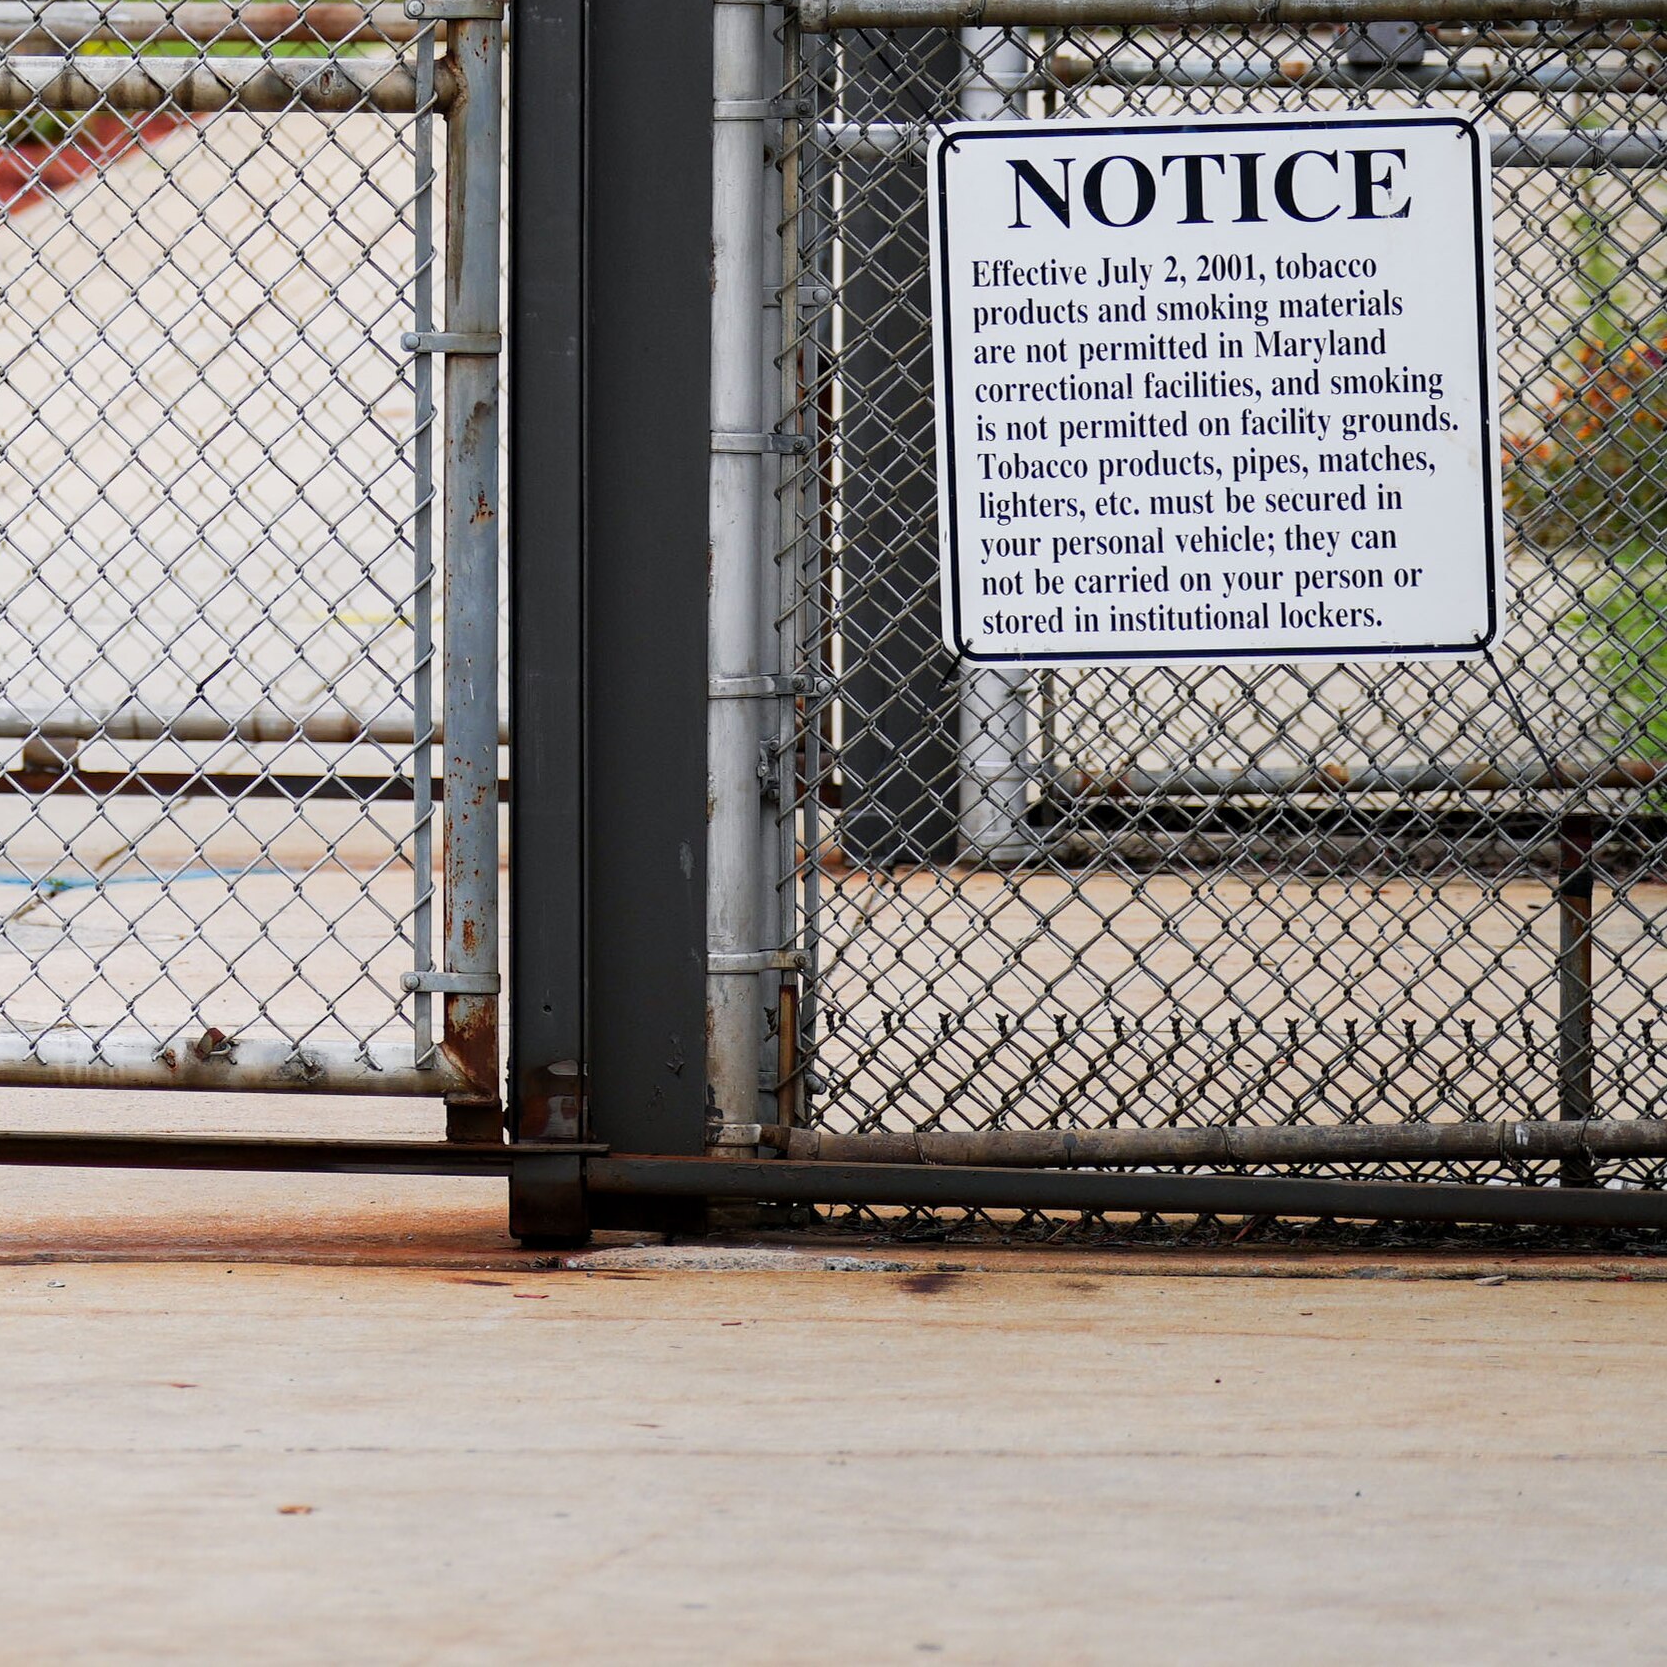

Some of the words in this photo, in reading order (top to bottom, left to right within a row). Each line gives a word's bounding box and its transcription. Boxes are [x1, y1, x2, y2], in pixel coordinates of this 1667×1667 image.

[1006, 149, 1411, 229] NOTICE
[972, 259, 1087, 287] Effective
[1097, 257, 1152, 290] July
[1164, 256, 1186, 287] 2,
[1197, 254, 1265, 285] 2001,
[1275, 252, 1376, 280] tobacco
[973, 298, 1088, 333] products
[1098, 295, 1146, 323] and
[1157, 293, 1269, 326] smoking
[1280, 289, 1403, 318] materials
[974, 345, 1015, 364] are
[1027, 339, 1067, 363] not
[1079, 333, 1207, 369] permitted
[1219, 332, 1243, 358] in
[1254, 328, 1386, 364] Maryland
[975, 373, 1133, 403] correctional
[1144, 370, 1261, 401] facilities,
[1272, 369, 1319, 396] and
[1331, 366, 1443, 400] smoking
[977, 415, 996, 441] is
[1007, 416, 1048, 440] not
[1060, 410, 1187, 447] permitted
[1199, 418, 1230, 436] on
[1241, 407, 1331, 441] facility
[1342, 405, 1458, 441] grounds.
[977, 453, 1088, 479] Tobacco
[1099, 450, 1222, 485] products,
[1233, 447, 1308, 482] pipes,
[1319, 445, 1435, 475] matches,
[979, 492, 1085, 526] lighters,
[1096, 492, 1139, 516] etc.
[1150, 490, 1214, 514] must
[1225, 487, 1255, 513] be
[1266, 484, 1366, 512] secured
[1377, 483, 1402, 510] in
[981, 537, 1041, 564] your
[1052, 527, 1164, 563] personal
[1175, 525, 1274, 556] vehicle;
[1285, 524, 1340, 557] they
[1351, 530, 1397, 549] can
[982, 571, 1023, 596] not
[1035, 568, 1064, 595] be
[1075, 566, 1169, 594] carried
[1180, 573, 1211, 592] on
[1223, 571, 1283, 598] your
[1295, 569, 1383, 597] person
[1394, 568, 1423, 587] or
[983, 607, 1063, 634] stored
[1075, 606, 1099, 632] in
[1110, 602, 1269, 631] institutional
[1280, 601, 1382, 628] lockers.
